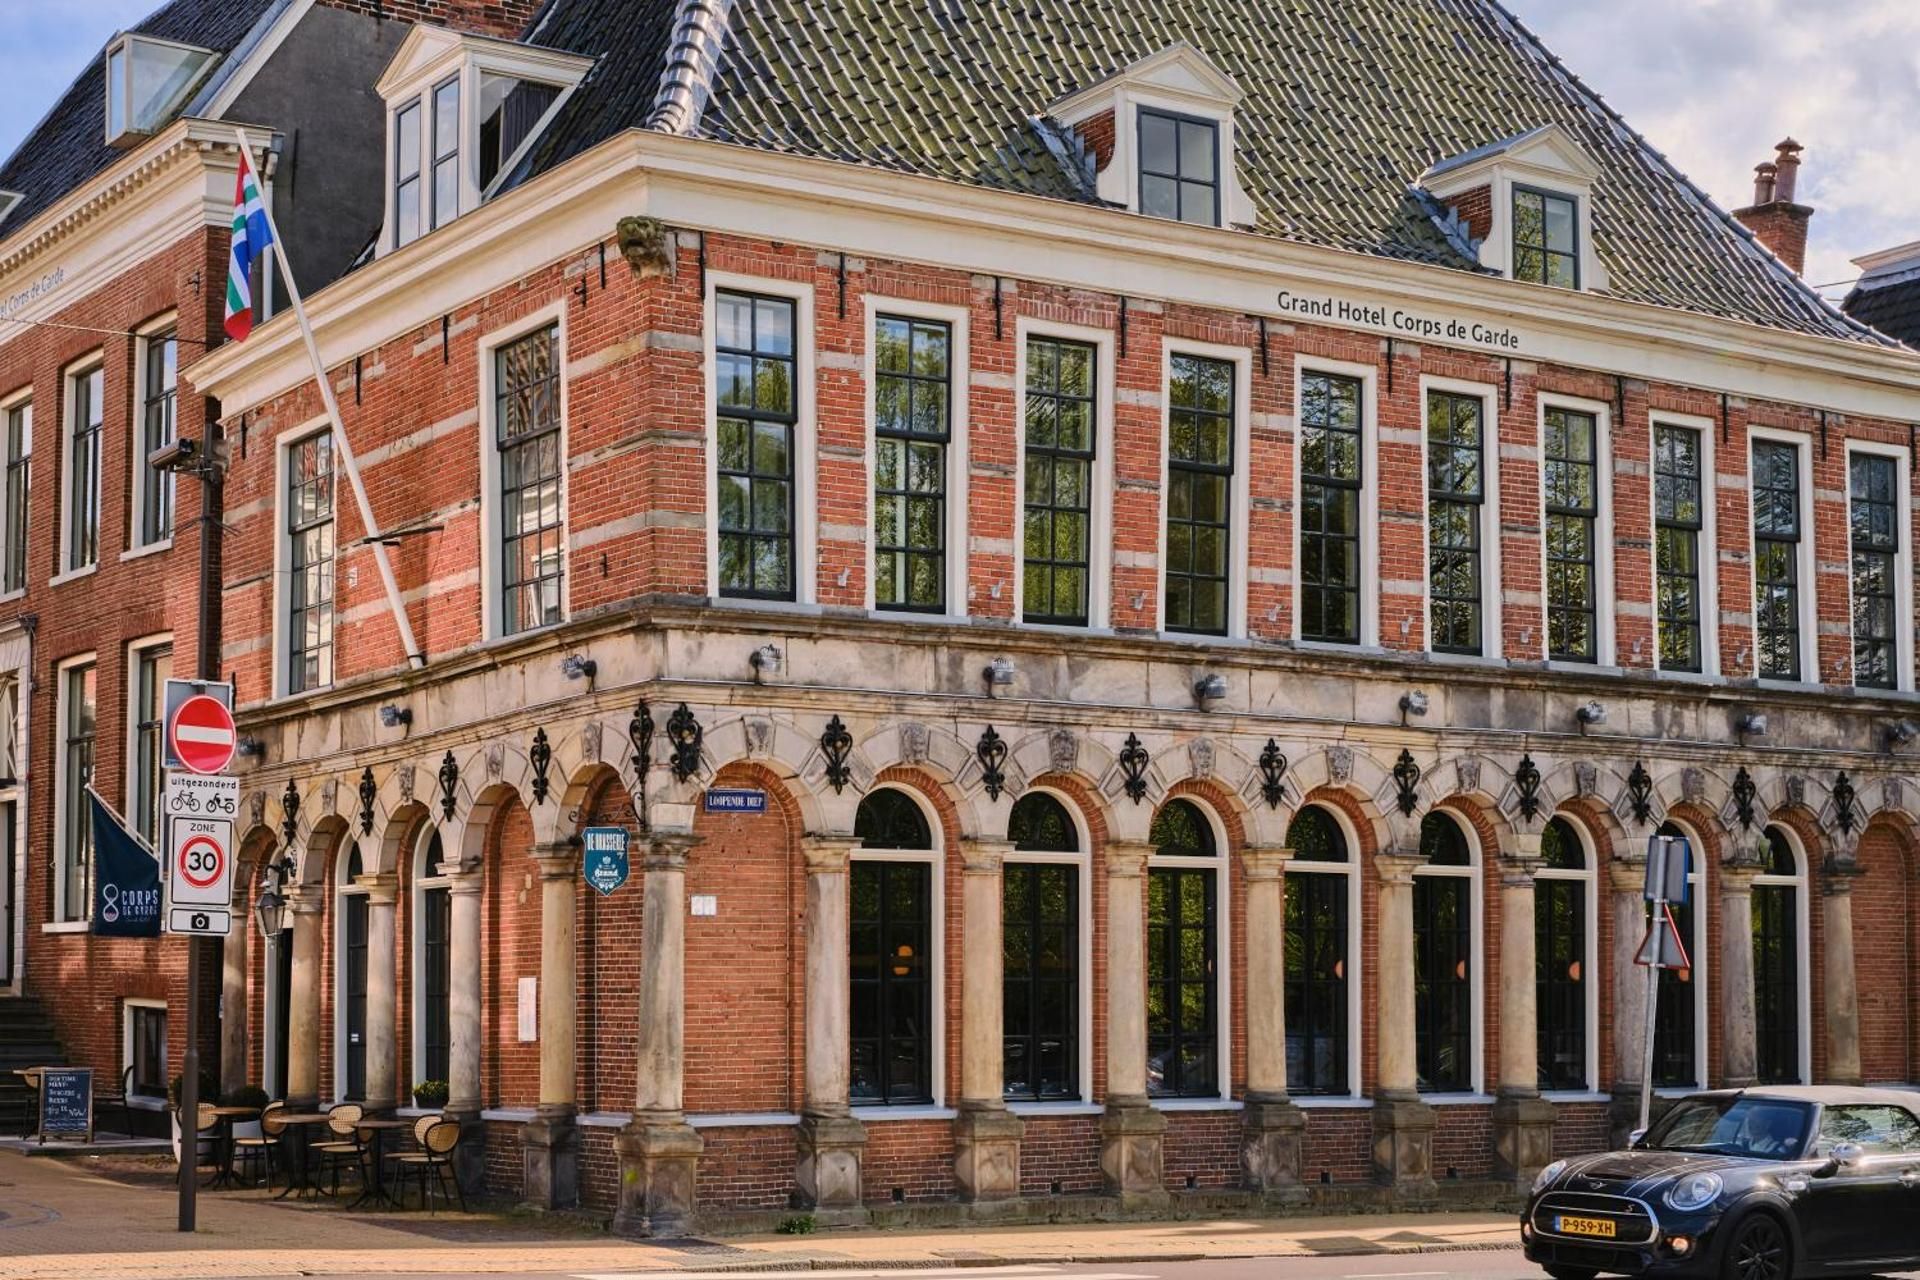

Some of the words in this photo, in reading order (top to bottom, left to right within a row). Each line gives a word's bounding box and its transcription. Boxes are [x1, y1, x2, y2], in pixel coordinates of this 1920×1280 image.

[31, 282, 40, 298] de
[1277, 291, 1332, 317] Grand
[1338, 301, 1386, 326] Hotel
[1393, 310, 1441, 336] Corps
[1446, 319, 1467, 340] de
[1471, 323, 1518, 349] Garde
[171, 777, 237, 790] uitgezonderd
[190, 822, 216, 833] ZONE
[188, 851, 217, 872] 30
[122, 889, 159, 906] CORPS
[1563, 1217, 1613, 1235] P-959-XH
